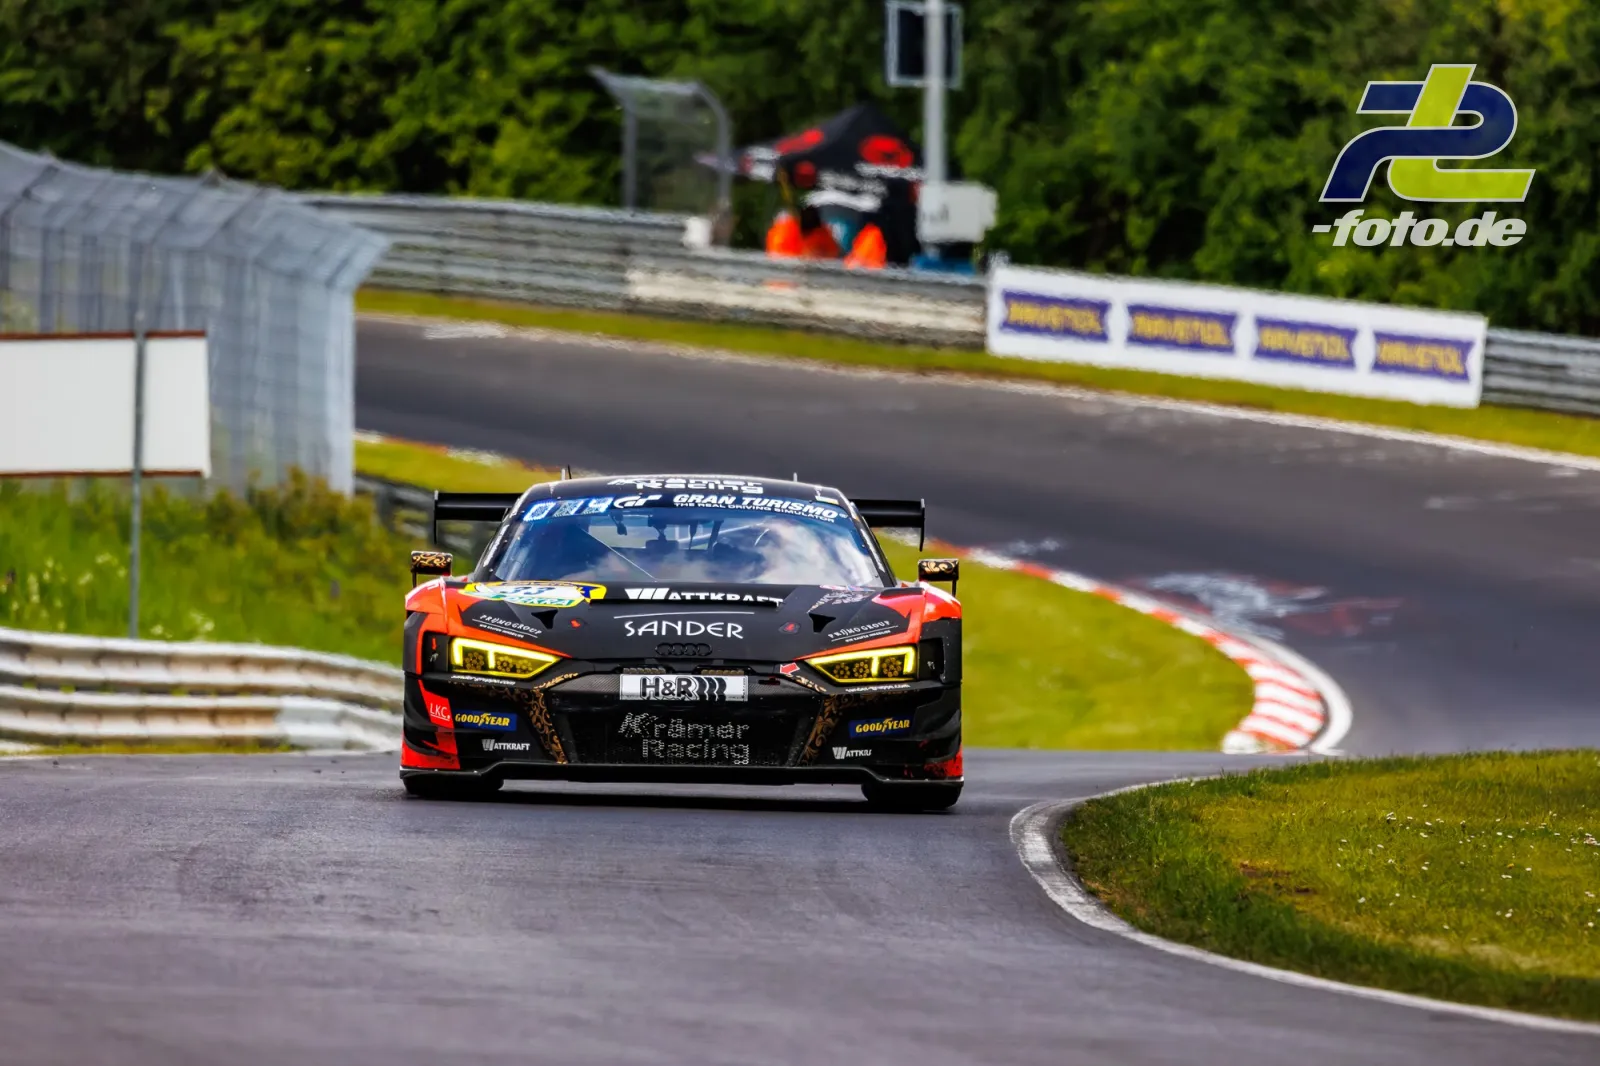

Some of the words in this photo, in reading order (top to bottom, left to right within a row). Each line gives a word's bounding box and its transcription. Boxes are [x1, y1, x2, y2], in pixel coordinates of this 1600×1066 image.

[673, 493, 735, 506] GRAN
[741, 496, 839, 519] TURISMO
[728, 504, 771, 512] DRIVING
[774, 507, 835, 523] SIMULATOR
[624, 620, 744, 639] SANDER
[641, 676, 695, 699] H&R
[455, 713, 511, 727] GOODYEAR
[618, 712, 750, 739] Krämer
[855, 718, 911, 733] GOODYEAR
[481, 739, 531, 751] WATTKRAFT
[642, 738, 750, 765] Racing
